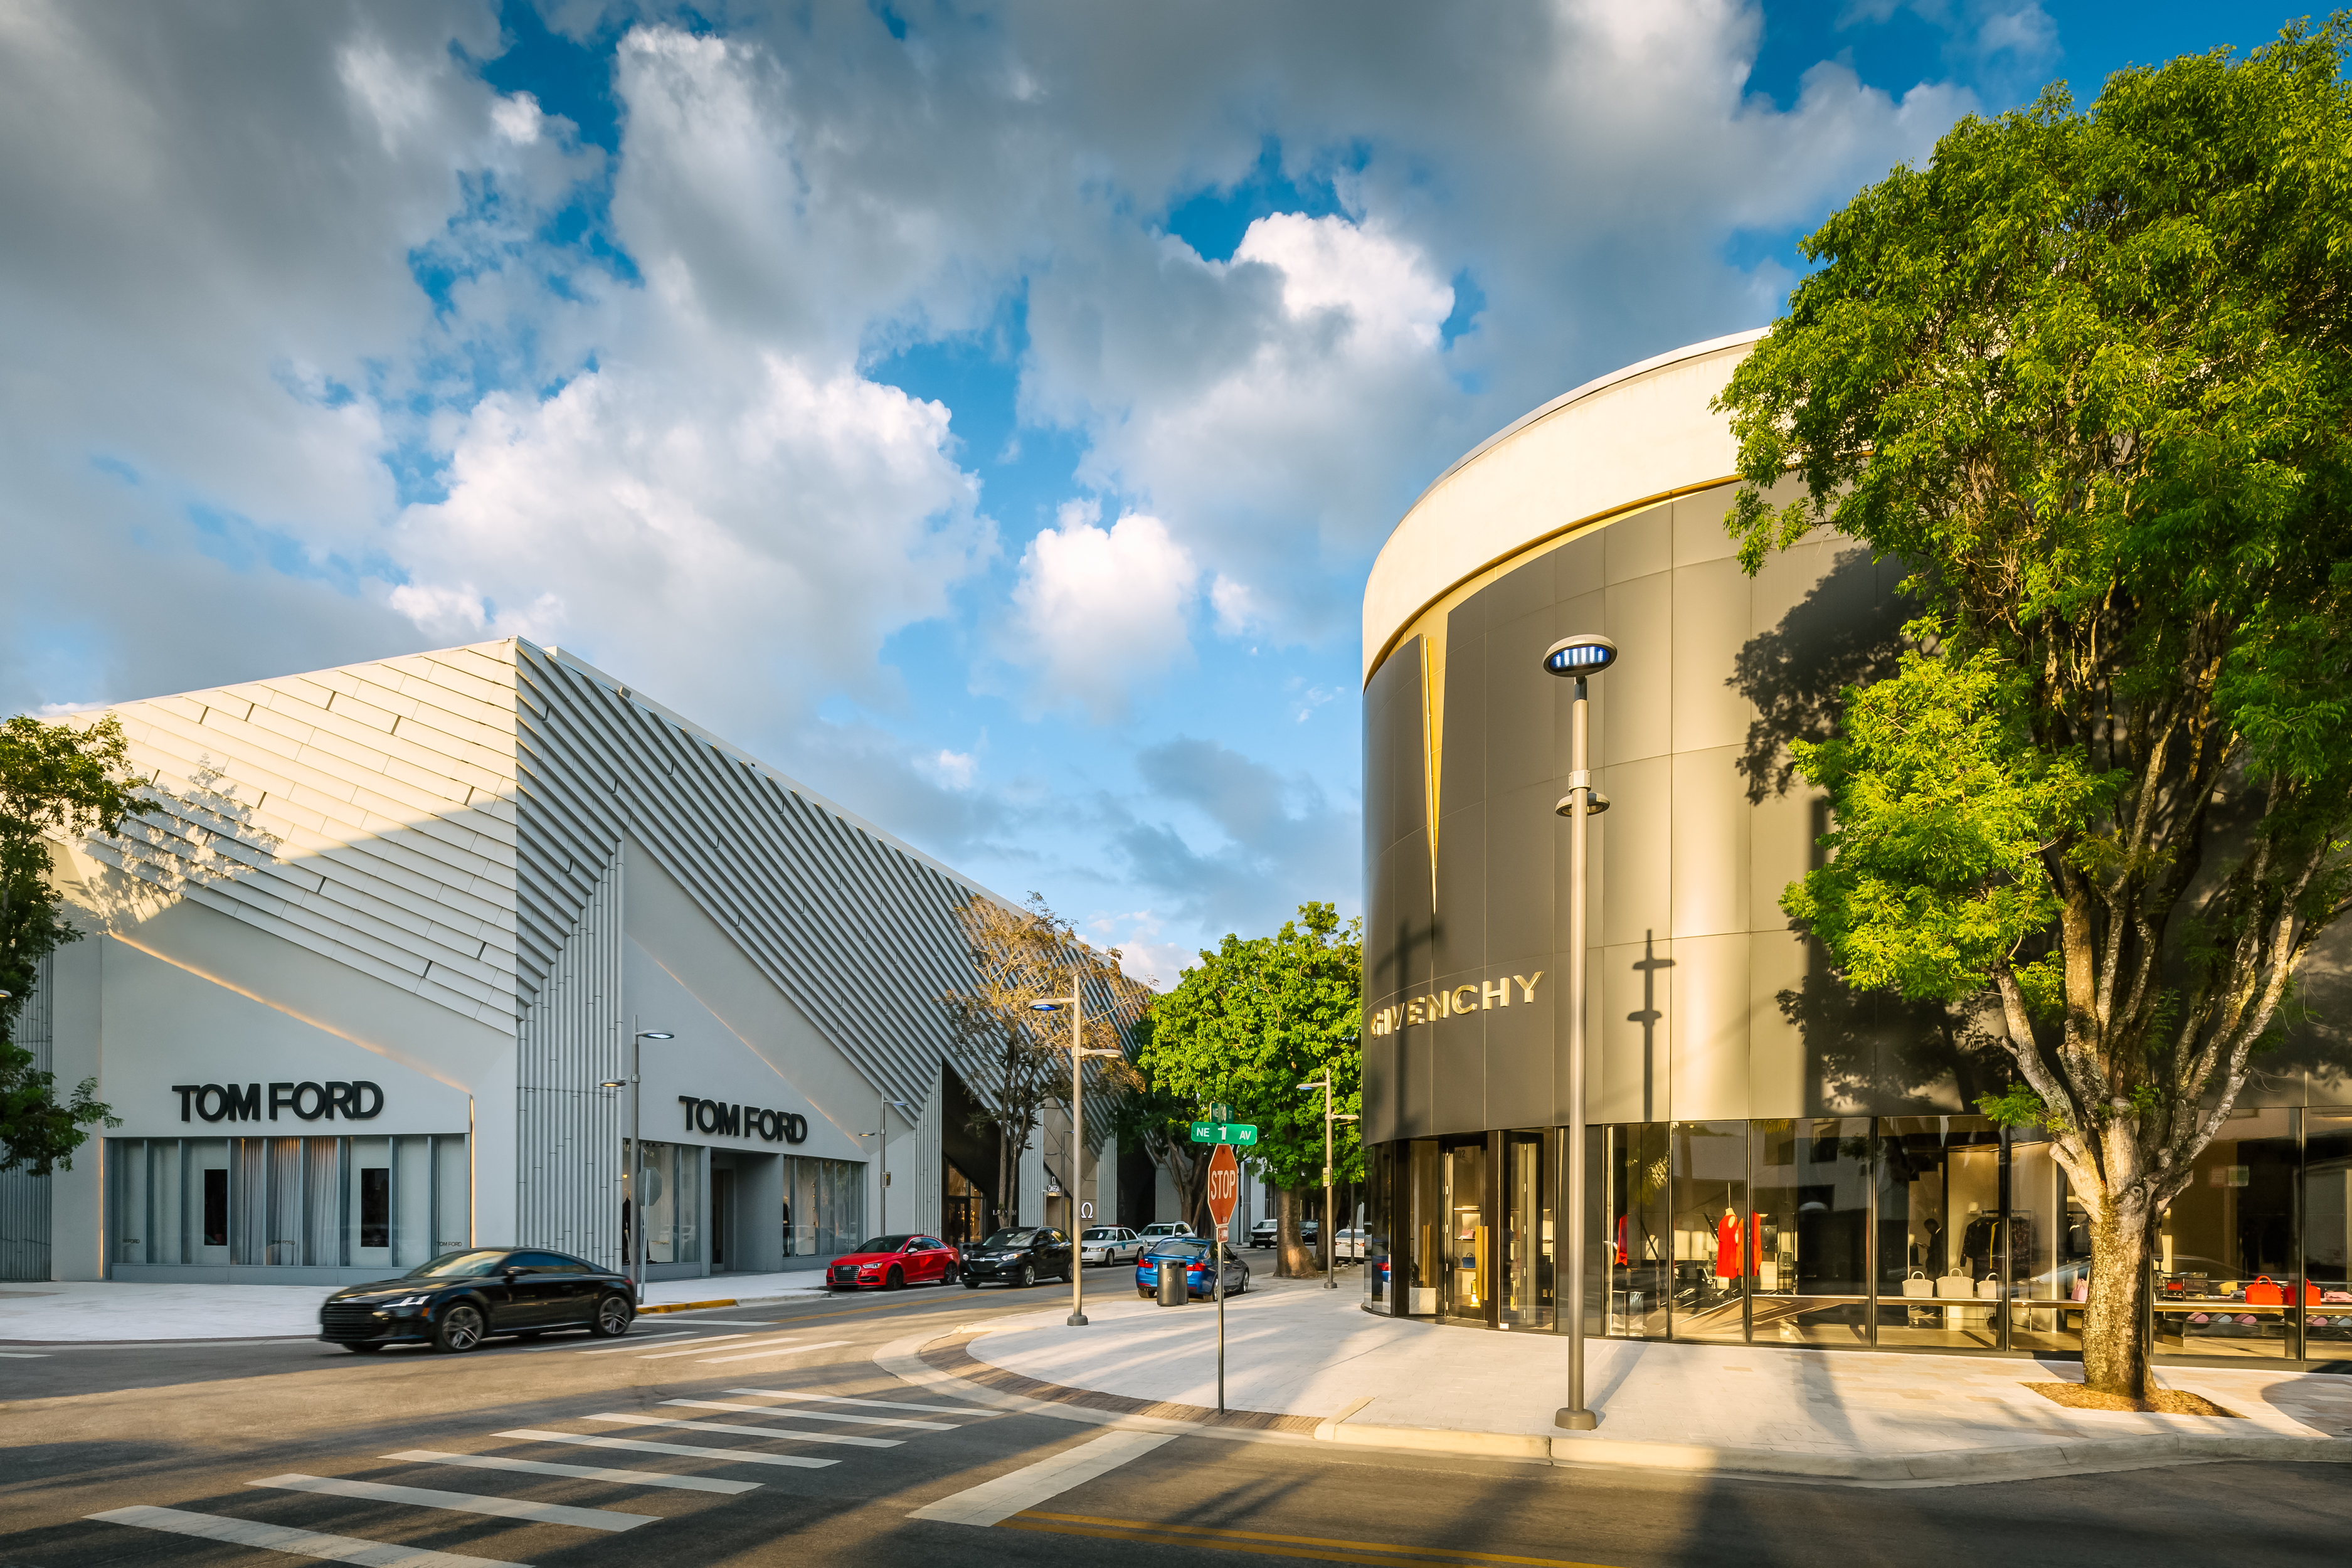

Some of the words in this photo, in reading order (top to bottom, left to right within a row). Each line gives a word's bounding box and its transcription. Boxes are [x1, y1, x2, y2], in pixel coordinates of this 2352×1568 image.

[1371, 971, 1544, 1039] GIVENCHY
[172, 1083, 261, 1122] TOM
[268, 1081, 384, 1120] FORD
[1212, 1108, 1219, 1118] NE
[1228, 1110, 1232, 1120] ST
[678, 1095, 740, 1137] TOM
[744, 1106, 808, 1143] FORD
[1196, 1127, 1210, 1137] NE
[1217, 1126, 1227, 1141] 1
[1239, 1130, 1252, 1140] AV
[1455, 1150, 1466, 1158] 102
[1210, 1170, 1236, 1200] STOP
